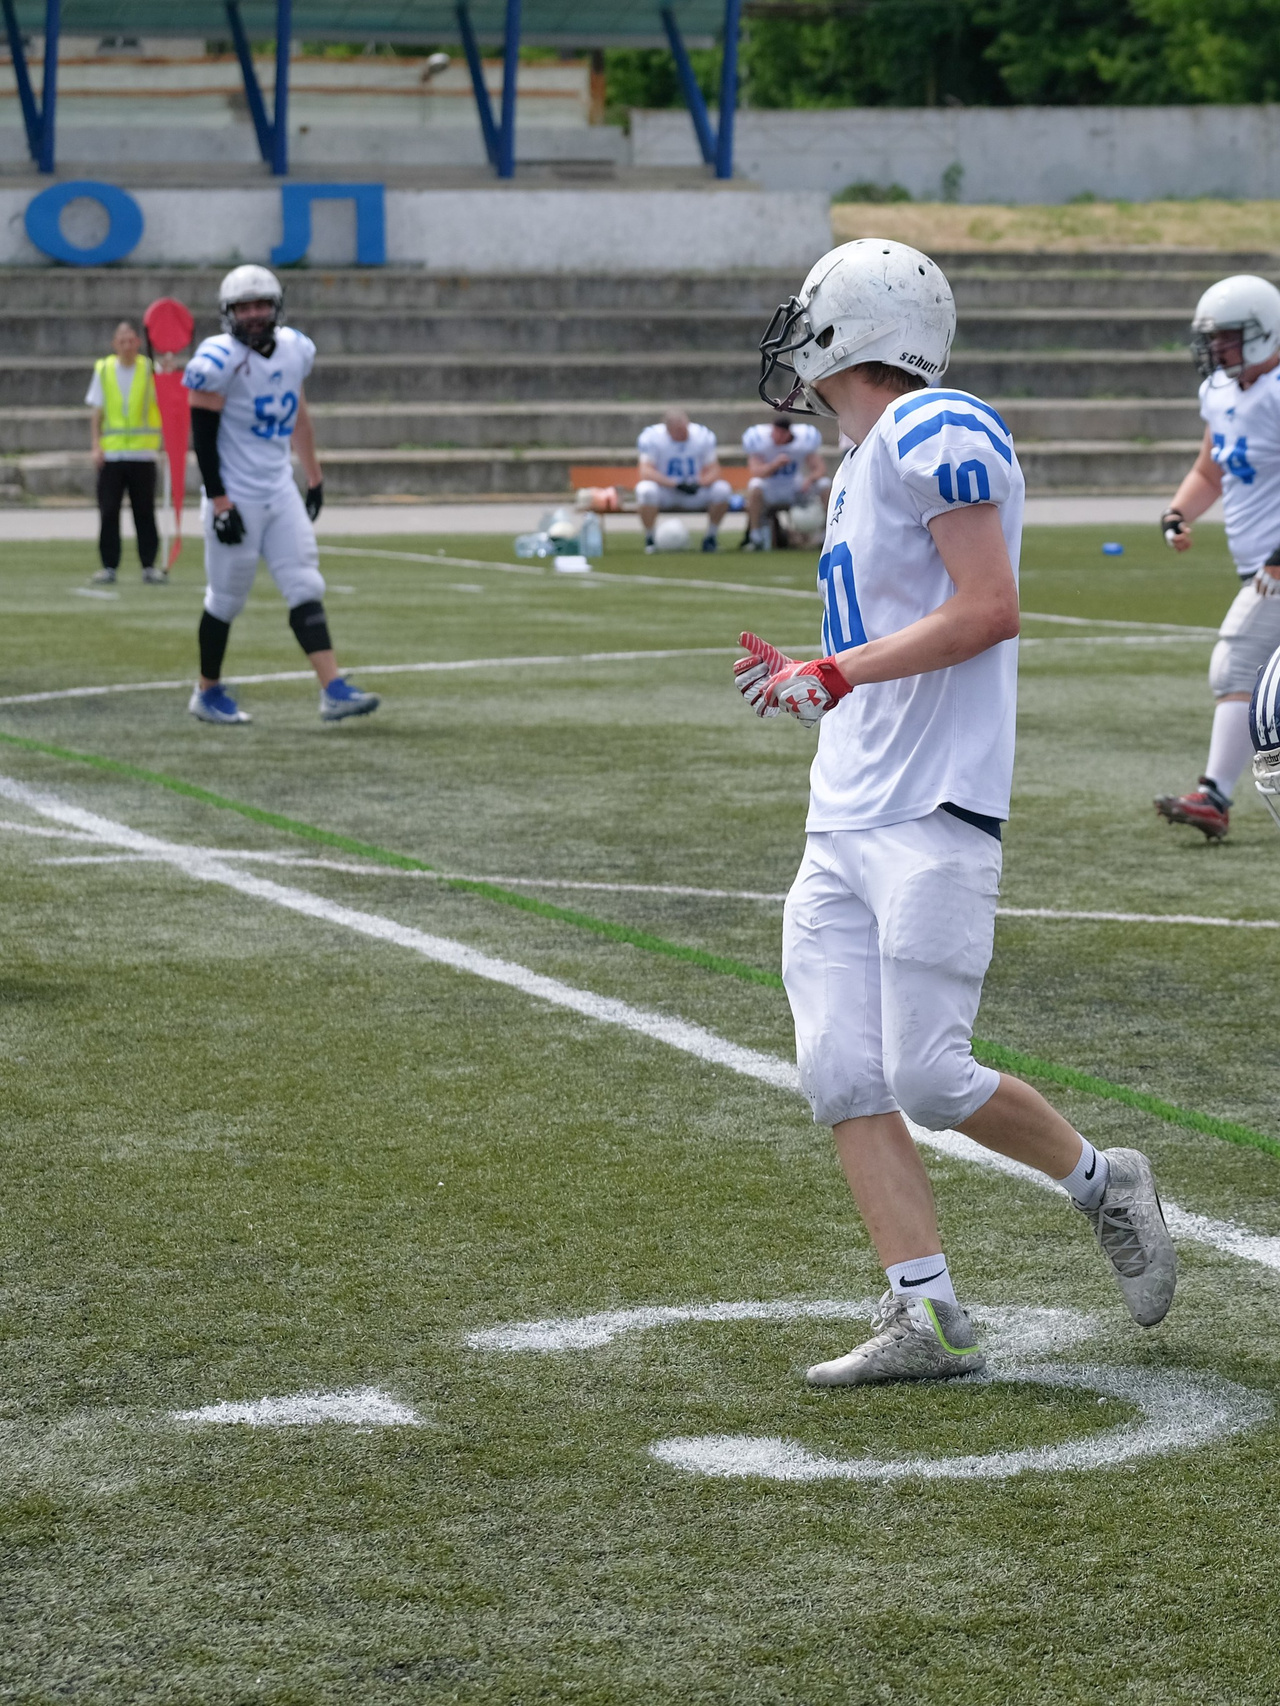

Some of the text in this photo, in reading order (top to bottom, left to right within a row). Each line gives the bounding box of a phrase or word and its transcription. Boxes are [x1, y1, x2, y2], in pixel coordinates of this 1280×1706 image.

[899, 351, 938, 375] schutt
[250, 391, 298, 439] 52
[932, 458, 991, 504] 10
